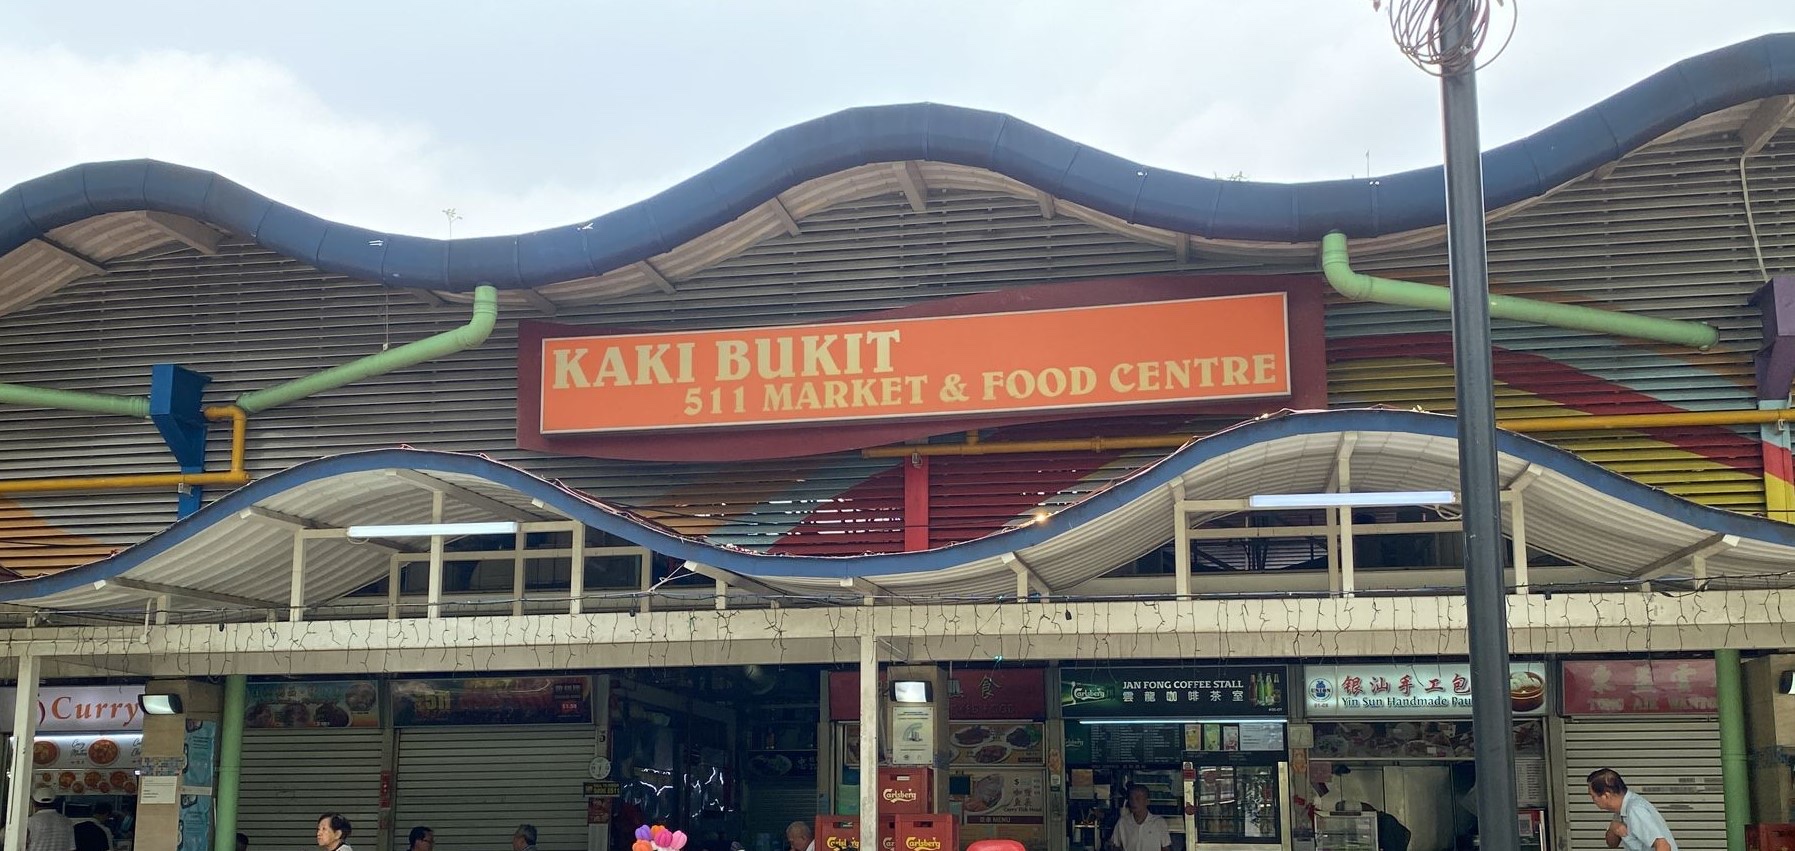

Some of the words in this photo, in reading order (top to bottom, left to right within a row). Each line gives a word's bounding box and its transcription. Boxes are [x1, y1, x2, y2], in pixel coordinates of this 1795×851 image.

[552, 342, 696, 390] KAKI
[715, 328, 901, 382] BUKIT
[684, 386, 748, 416] 511
[762, 375, 928, 412] MARKET
[938, 373, 967, 402] &
[982, 365, 1098, 401] FOOD
[1109, 354, 1277, 394] CENTRE
[1123, 681, 1141, 690] JAN
[1143, 681, 1172, 690] FONG
[1173, 680, 1211, 689] COFFEE
[1213, 680, 1244, 689] STALL
[1073, 687, 1105, 701] Carlsberg
[1341, 697, 1360, 707] Yin
[1362, 697, 1384, 707] Sun
[1387, 696, 1448, 707] Handmade
[51, 696, 140, 727] Curry
[883, 788, 917, 804] Carlsberg
[905, 836, 941, 851] Carlsberg
